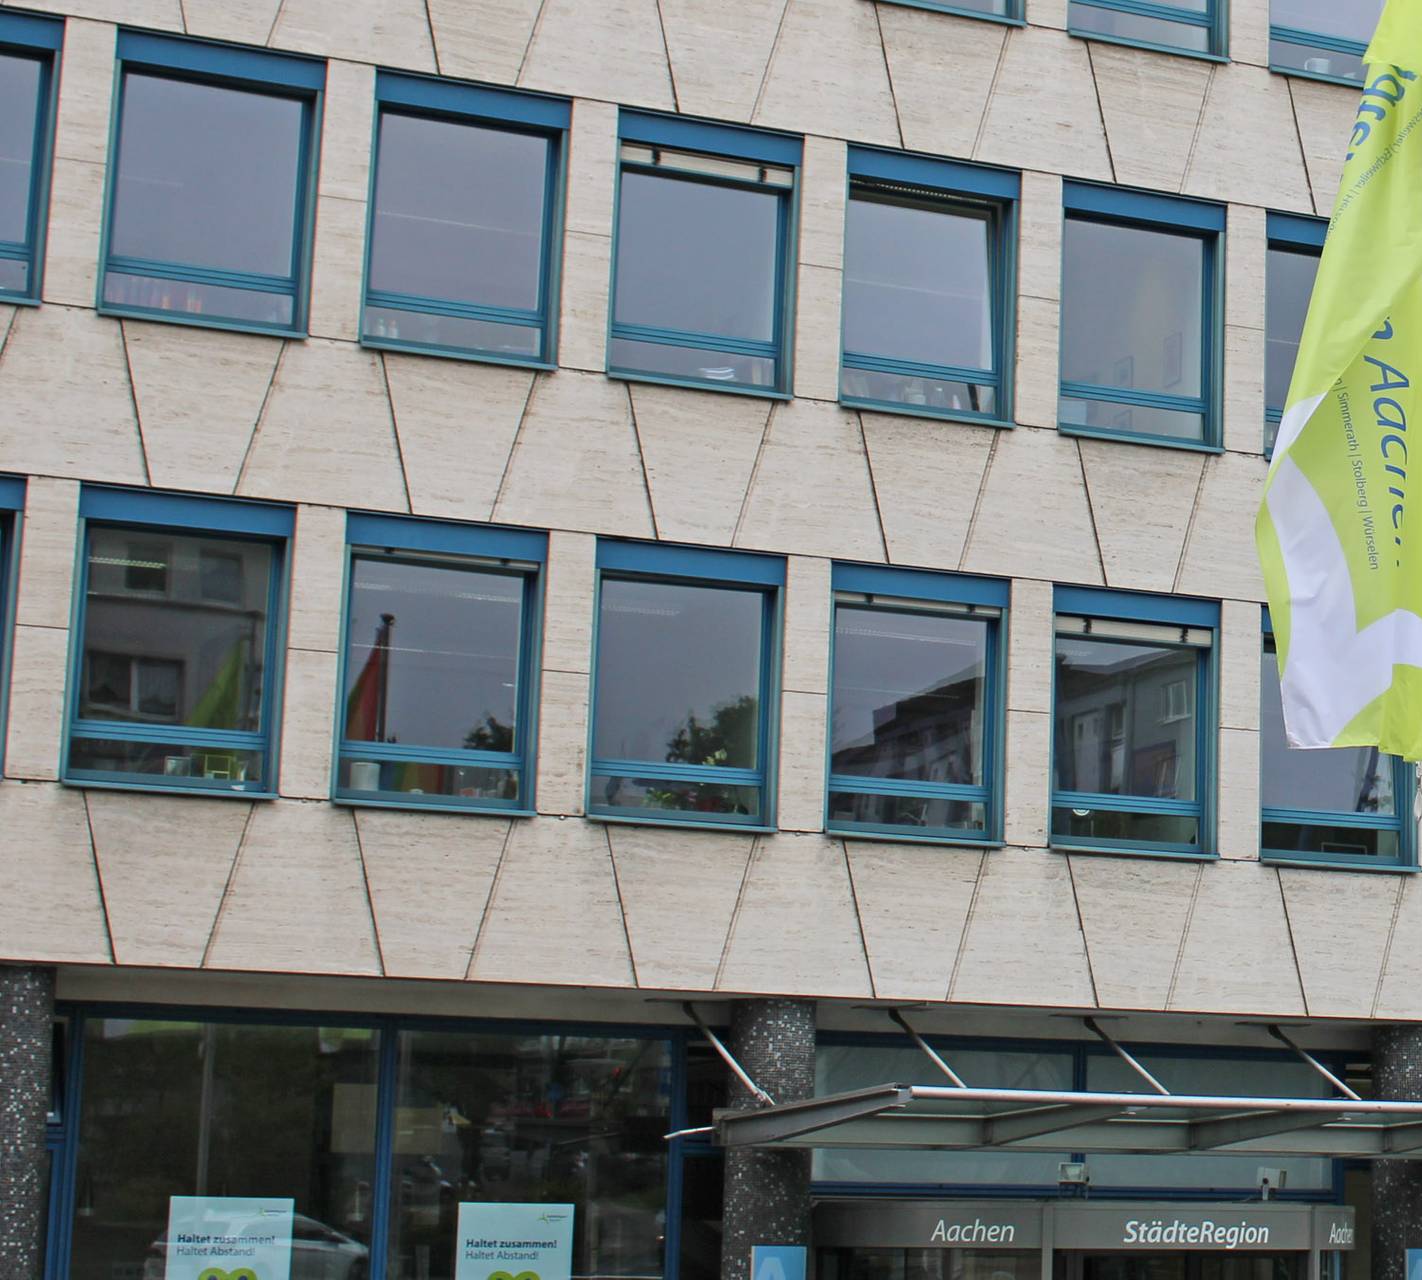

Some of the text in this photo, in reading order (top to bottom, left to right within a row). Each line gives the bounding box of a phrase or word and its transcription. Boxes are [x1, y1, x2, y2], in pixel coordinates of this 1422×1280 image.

[1337, 391, 1380, 570] Simmerath Stolberg Würselen
[177, 1234, 276, 1245] Haltet zusammen!
[930, 1218, 1016, 1243] Aachen
[1123, 1219, 1270, 1249] StädteRegion
[466, 1239, 557, 1249] Haltet zusammen!
[465, 1251, 496, 1260] Haltet
